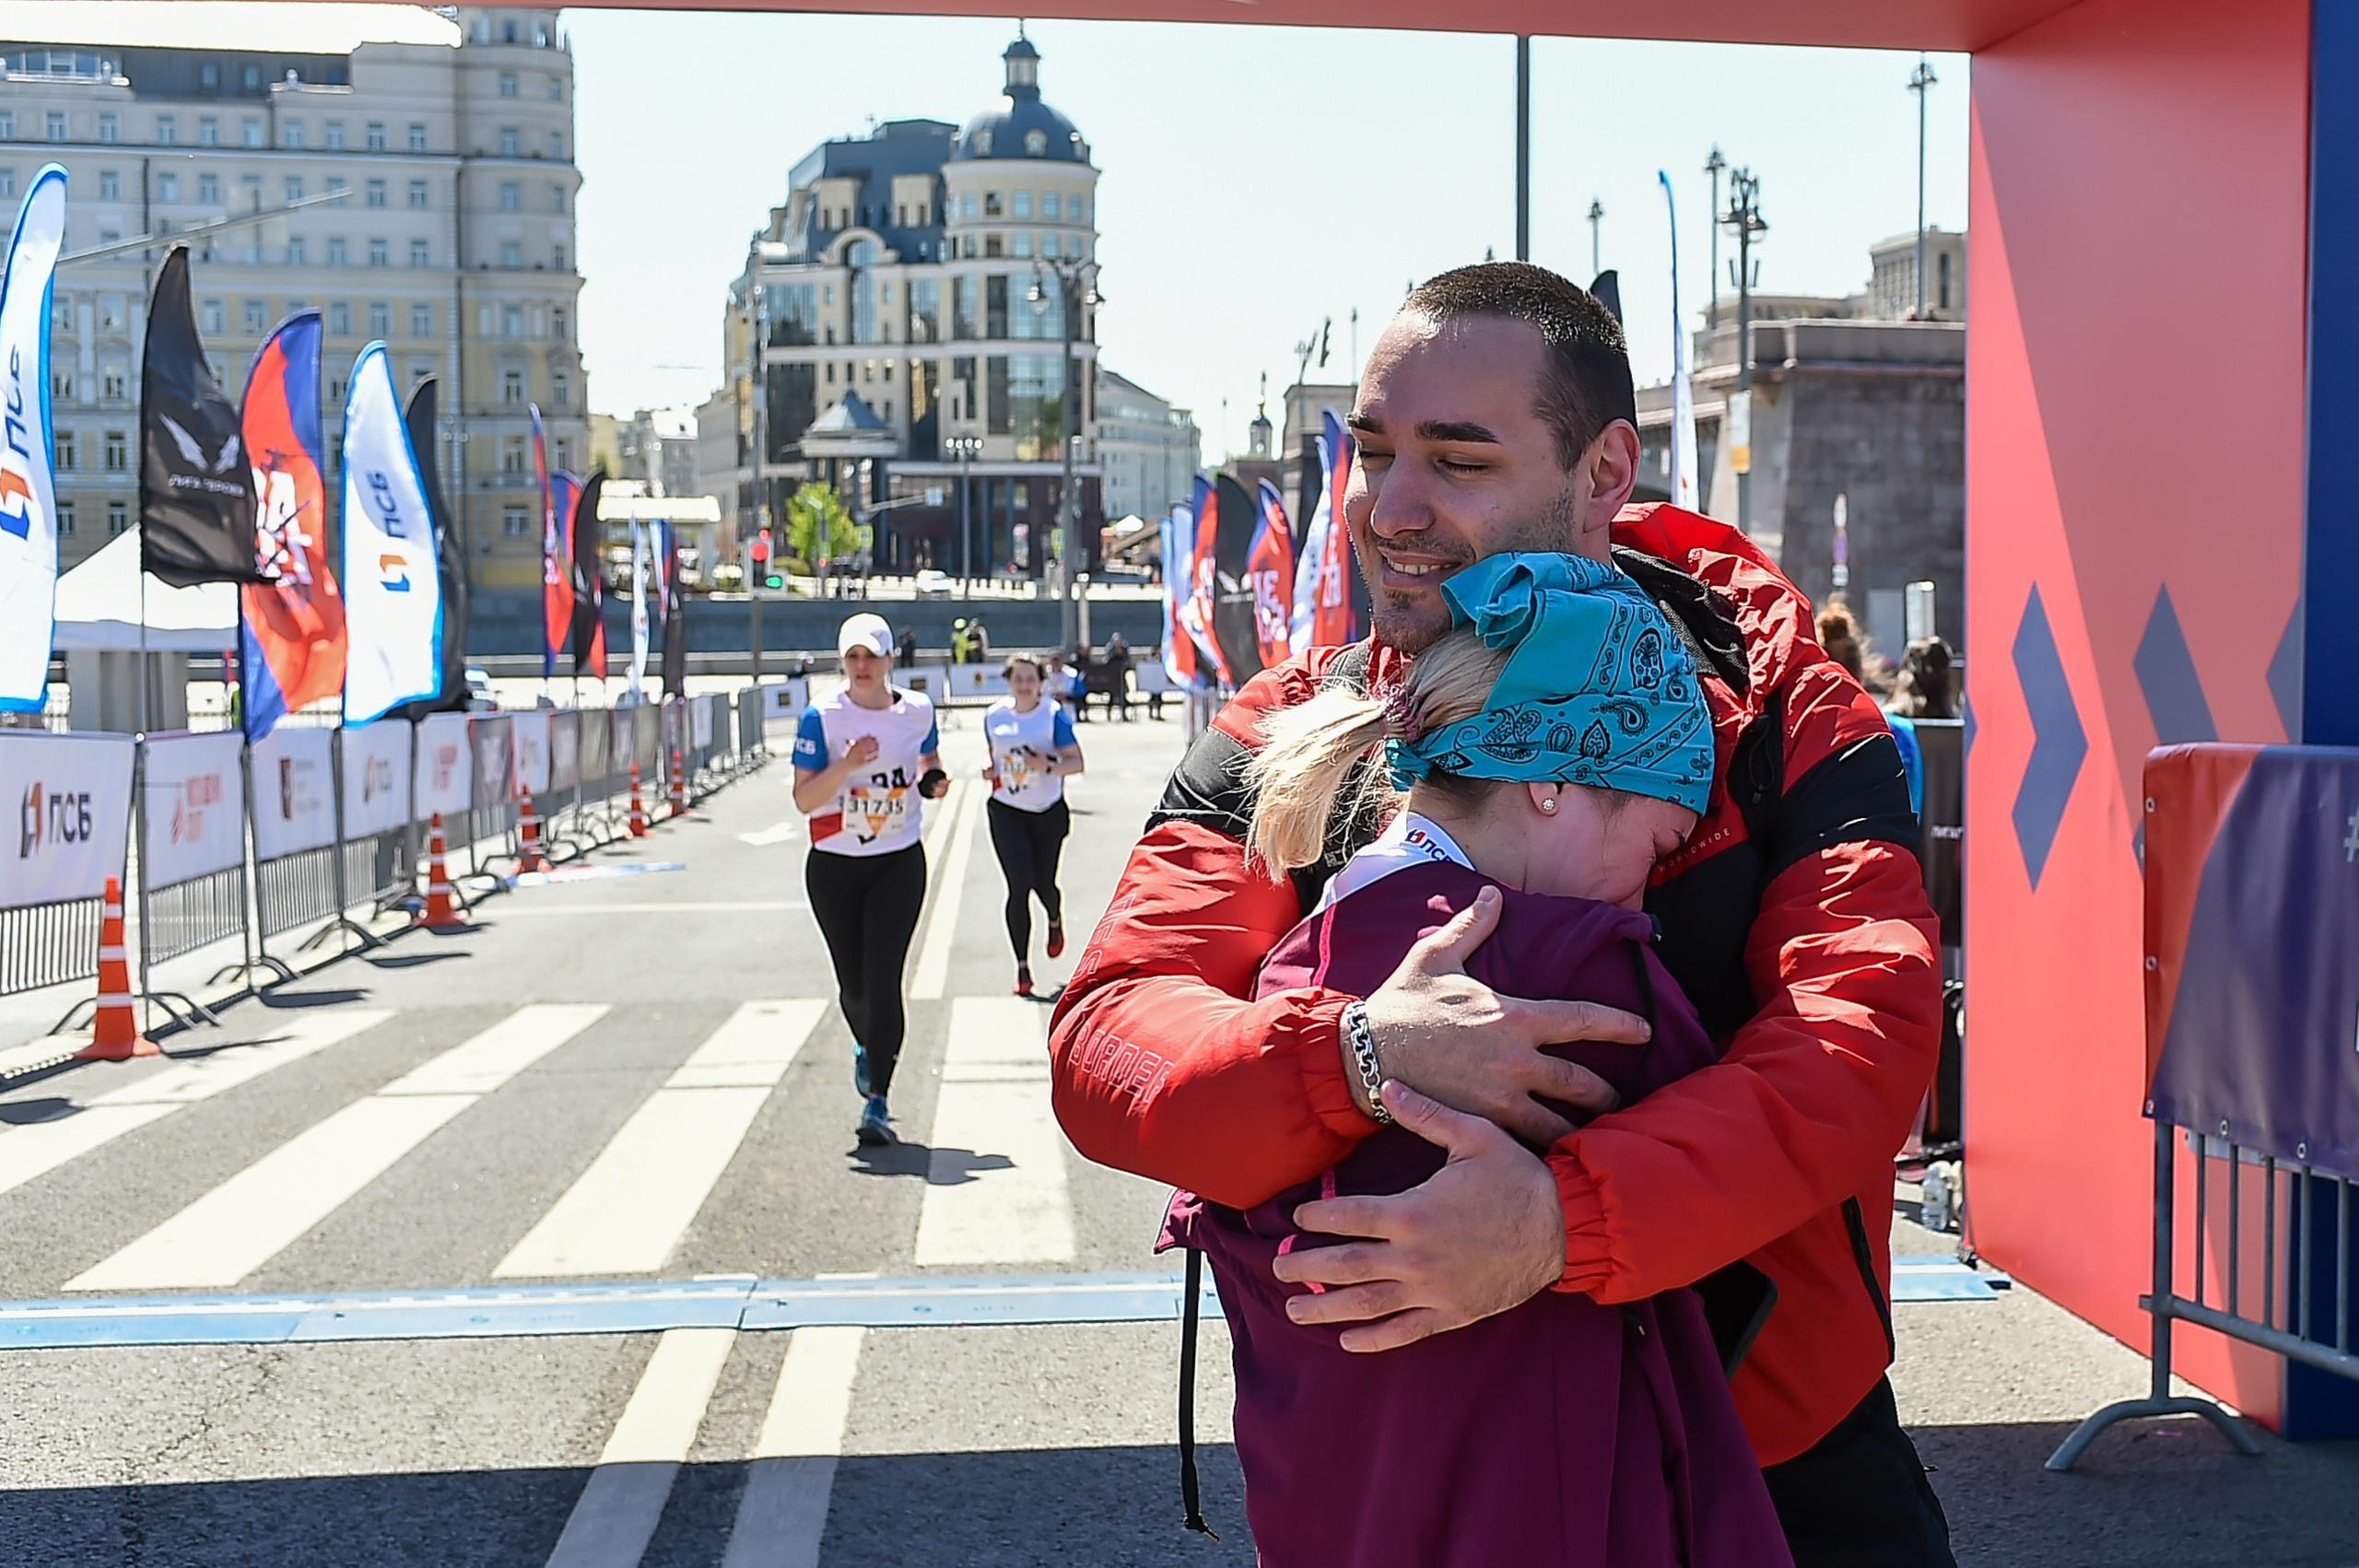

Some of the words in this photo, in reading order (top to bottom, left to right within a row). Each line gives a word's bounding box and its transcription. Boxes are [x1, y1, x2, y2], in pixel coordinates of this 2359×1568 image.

[365, 471, 406, 540] ПСБ
[49, 793, 91, 843] ПСБ
[849, 798, 904, 815] 31735
